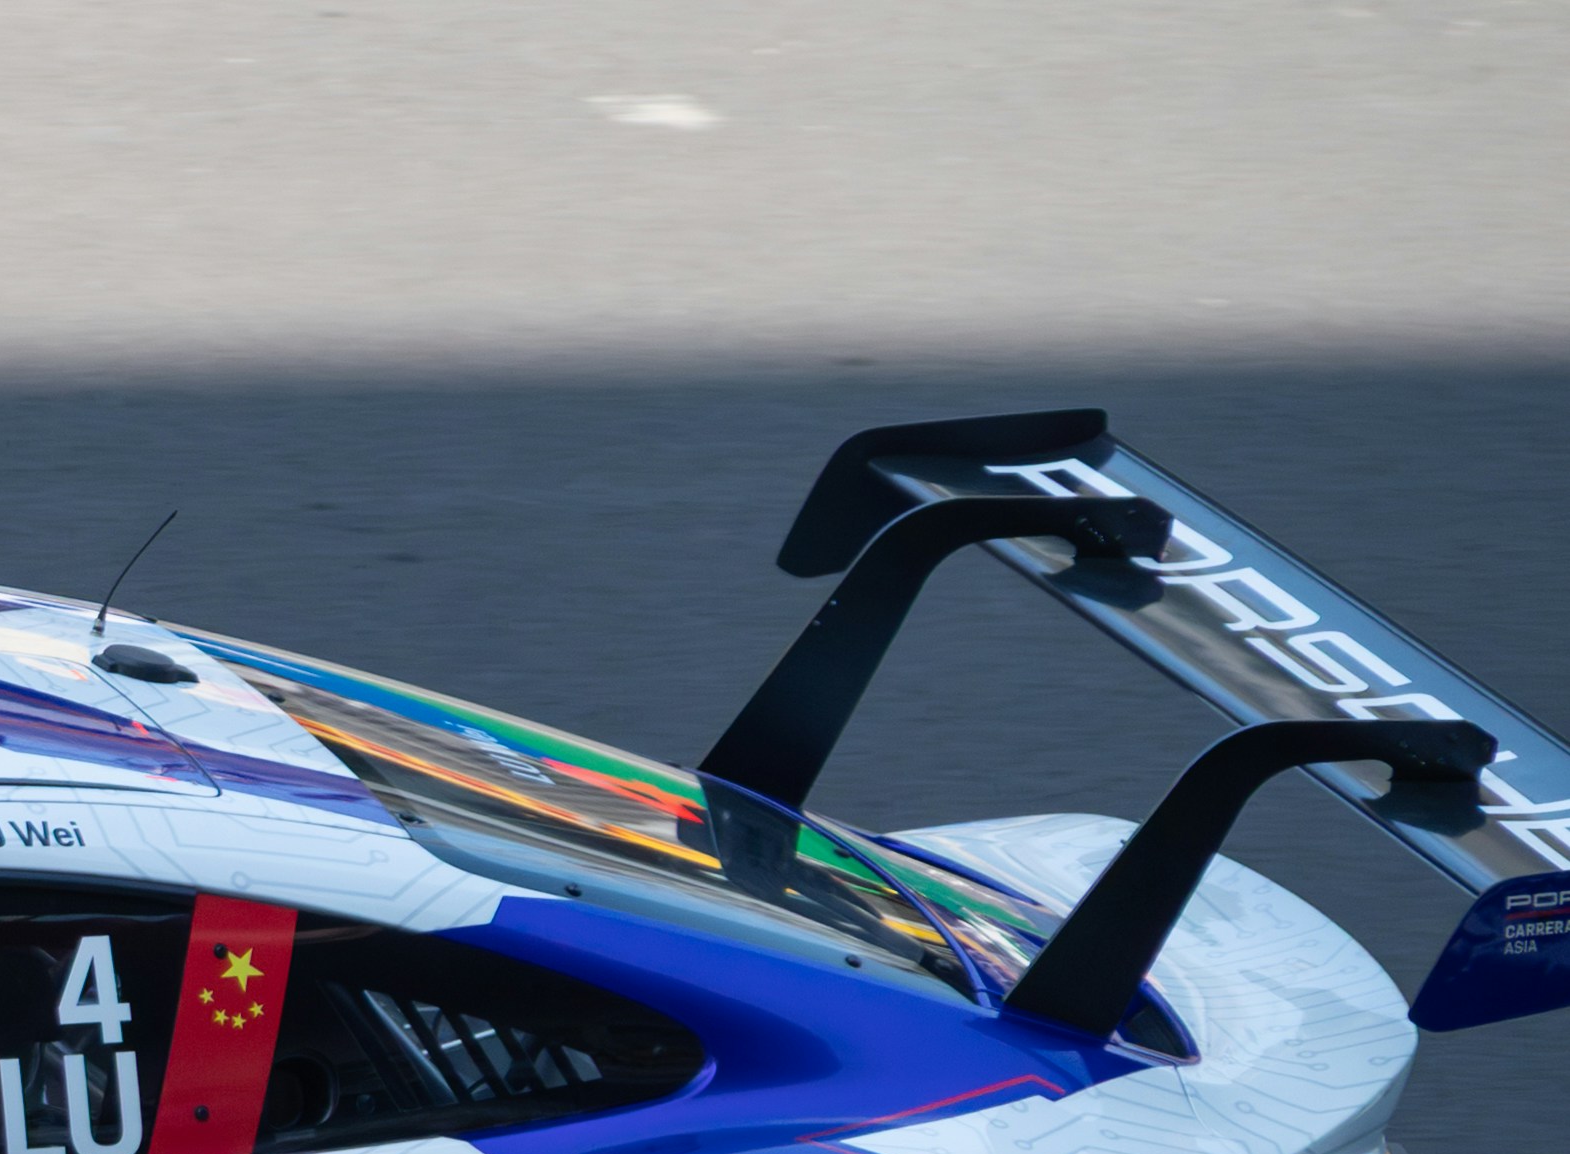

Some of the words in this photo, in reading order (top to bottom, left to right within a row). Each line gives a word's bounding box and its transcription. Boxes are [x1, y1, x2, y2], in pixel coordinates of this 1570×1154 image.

[8, 821, 86, 847] Wei
[1504, 940, 1538, 955] ASIA
[58, 935, 131, 1044] 4
